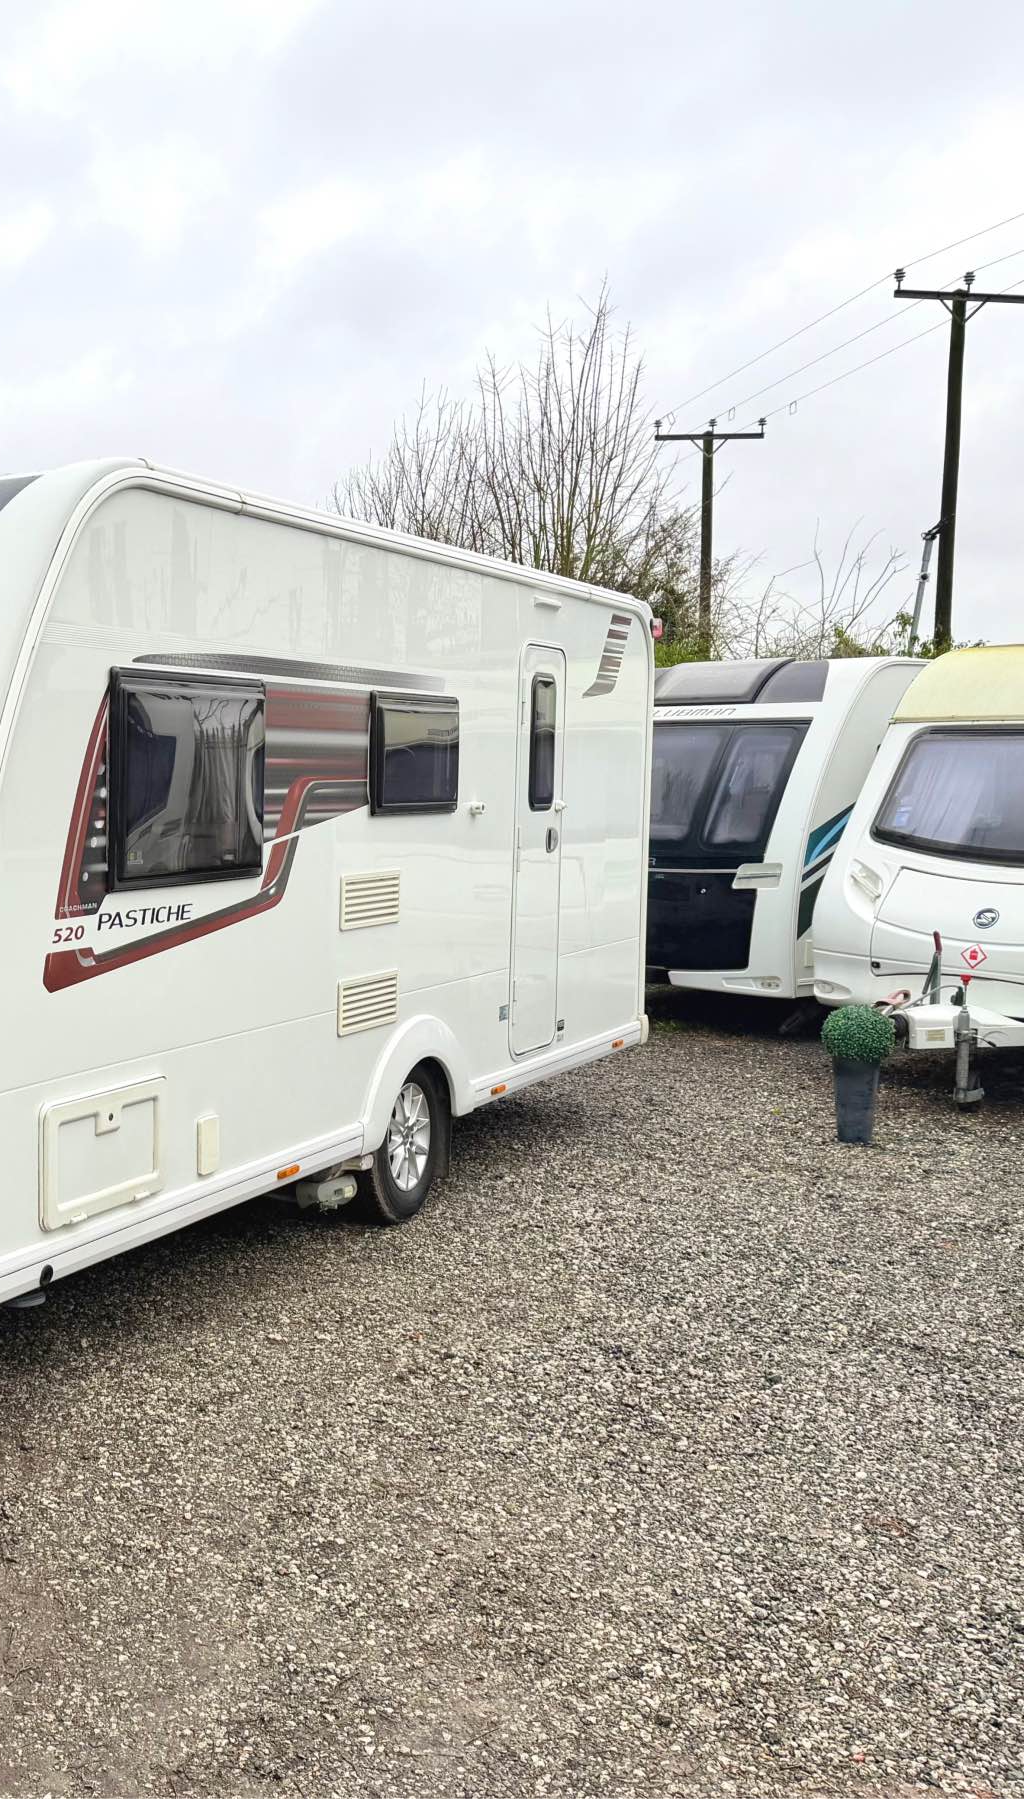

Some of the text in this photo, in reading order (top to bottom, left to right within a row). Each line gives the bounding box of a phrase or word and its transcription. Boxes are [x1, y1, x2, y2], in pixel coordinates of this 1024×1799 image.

[59, 902, 98, 913] COACHMAN
[97, 903, 194, 931] PASTICHE
[52, 925, 85, 944] 520
